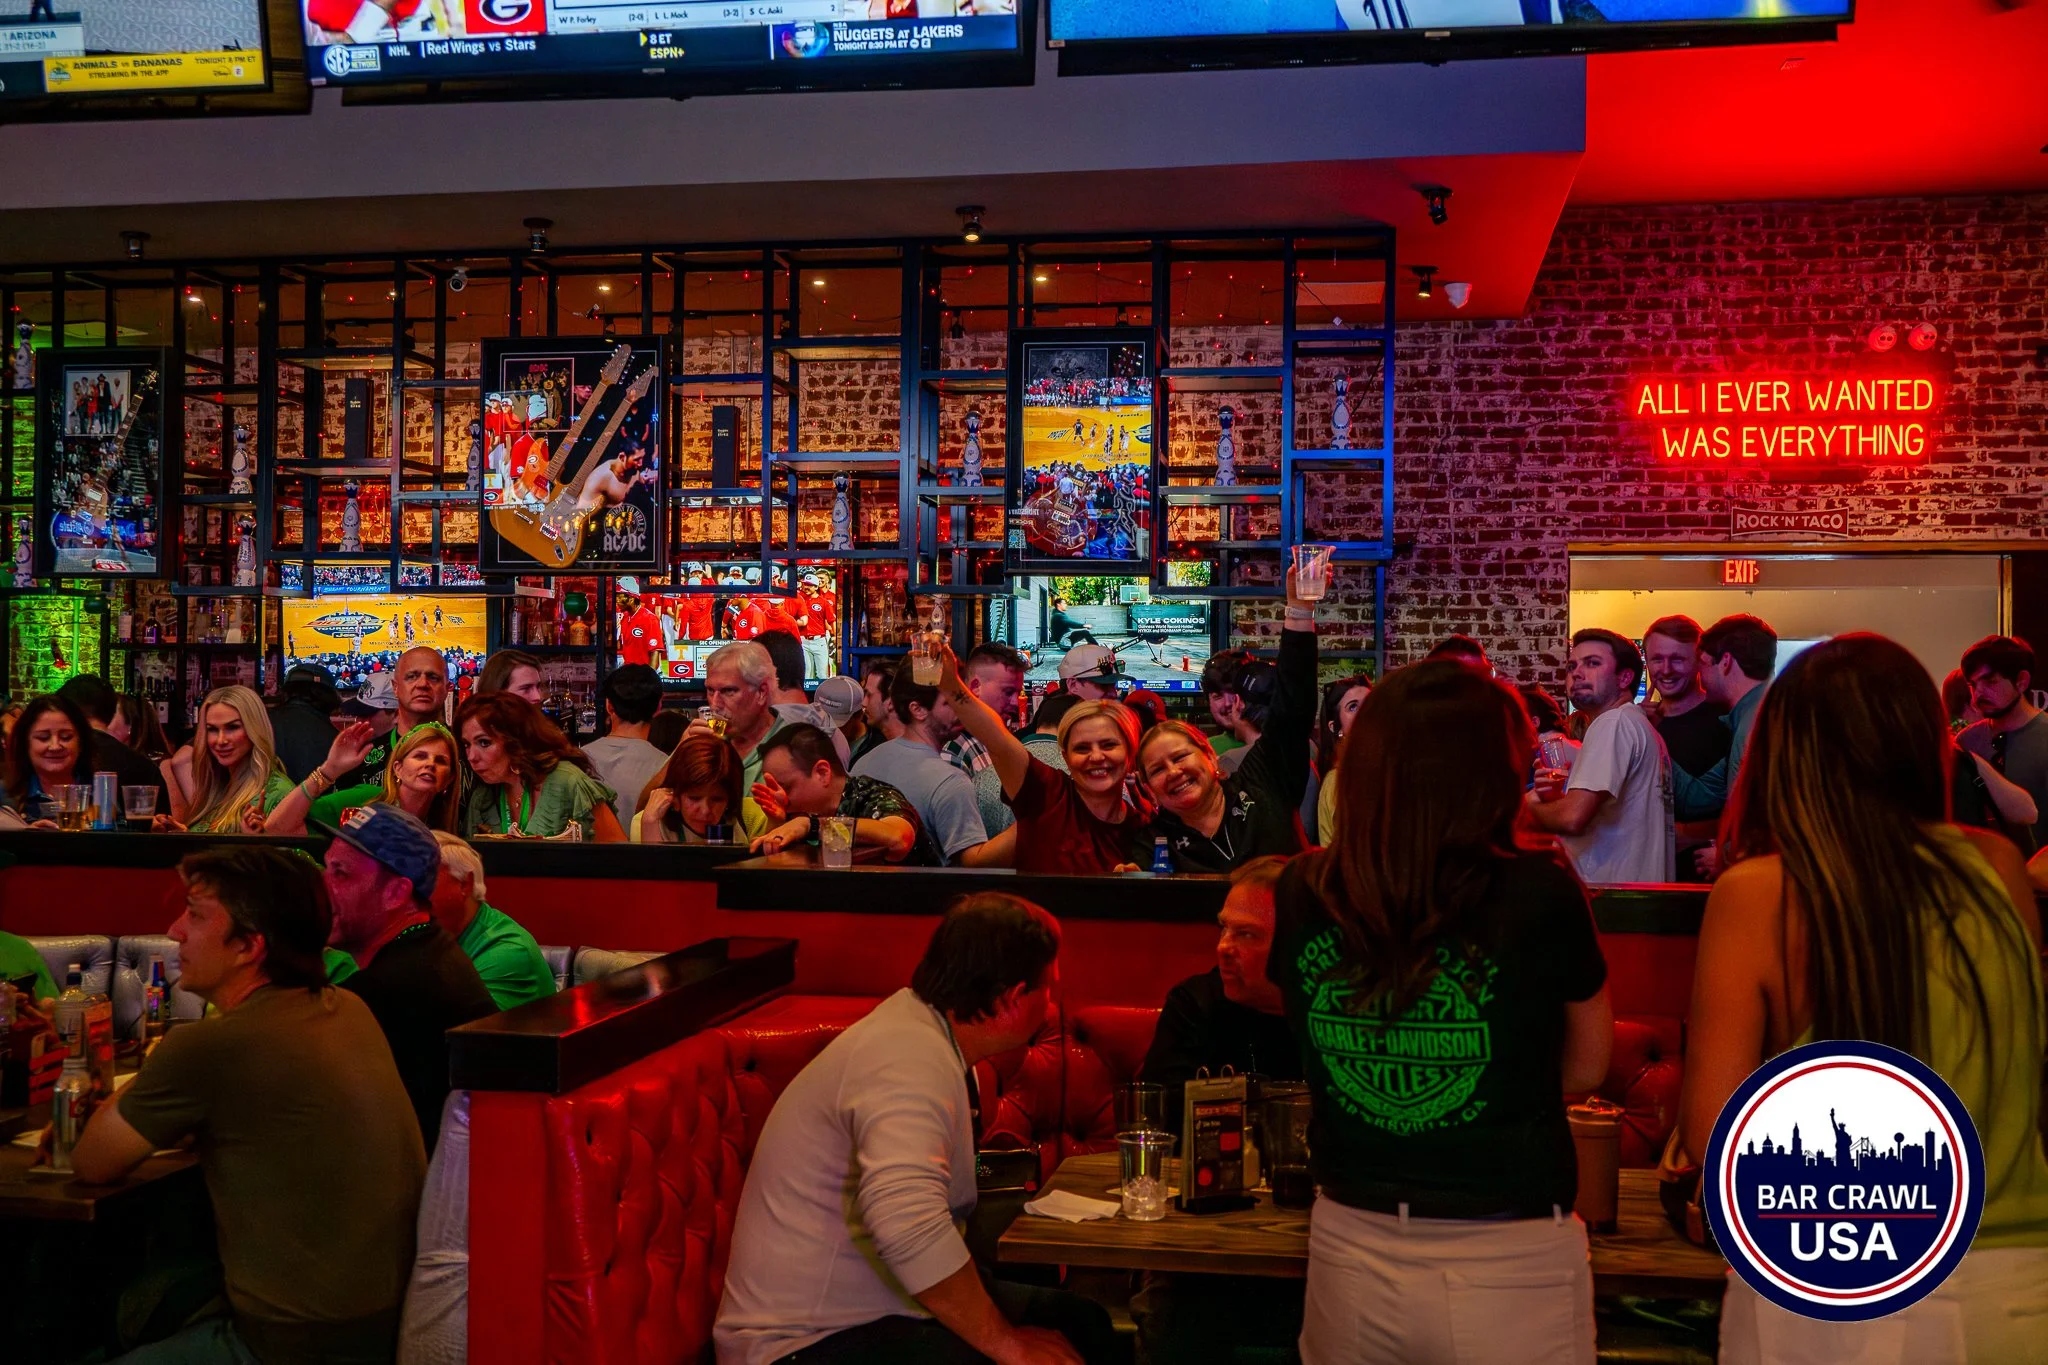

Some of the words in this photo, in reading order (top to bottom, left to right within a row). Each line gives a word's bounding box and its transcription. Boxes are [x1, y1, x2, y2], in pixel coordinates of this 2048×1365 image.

[629, 13, 644, 22] (2-0)
[10, 31, 57, 40] ARIZONA
[650, 34, 658, 45] 8
[659, 34, 672, 44] ET
[833, 28, 894, 42] NUGGETS
[897, 30, 910, 40] AT
[914, 25, 964, 39] LAKERS
[389, 45, 411, 57] NHL
[427, 42, 449, 55] Red
[450, 41, 485, 56] Wings
[488, 42, 501, 52] vs
[505, 39, 536, 51] Stars
[834, 42, 868, 51] TONIGHT
[868, 40, 884, 50] 8:30
[884, 40, 897, 49] PM
[898, 39, 909, 48] ET
[650, 47, 685, 59] ESPN+
[74, 61, 118, 70] ANIMALS
[133, 58, 183, 68] BANANAS
[195, 57, 226, 65] TONIGHT
[328, 48, 350, 73] SEC
[89, 71, 130, 79] STREAMING
[1637, 384, 1690, 415] ALL
[1701, 384, 1706, 413] I
[1717, 381, 1791, 413] EVER
[1804, 379, 1934, 411] WANTED
[1662, 426, 1731, 458] WAS
[1742, 423, 1924, 457] EVERYTHING
[1736, 513, 1779, 529] ROCK
[1801, 513, 1844, 529] TACO
[1725, 560, 1757, 584] EXIT
[1313, 1020, 1482, 1058] HARLEY-DAVIDSON
